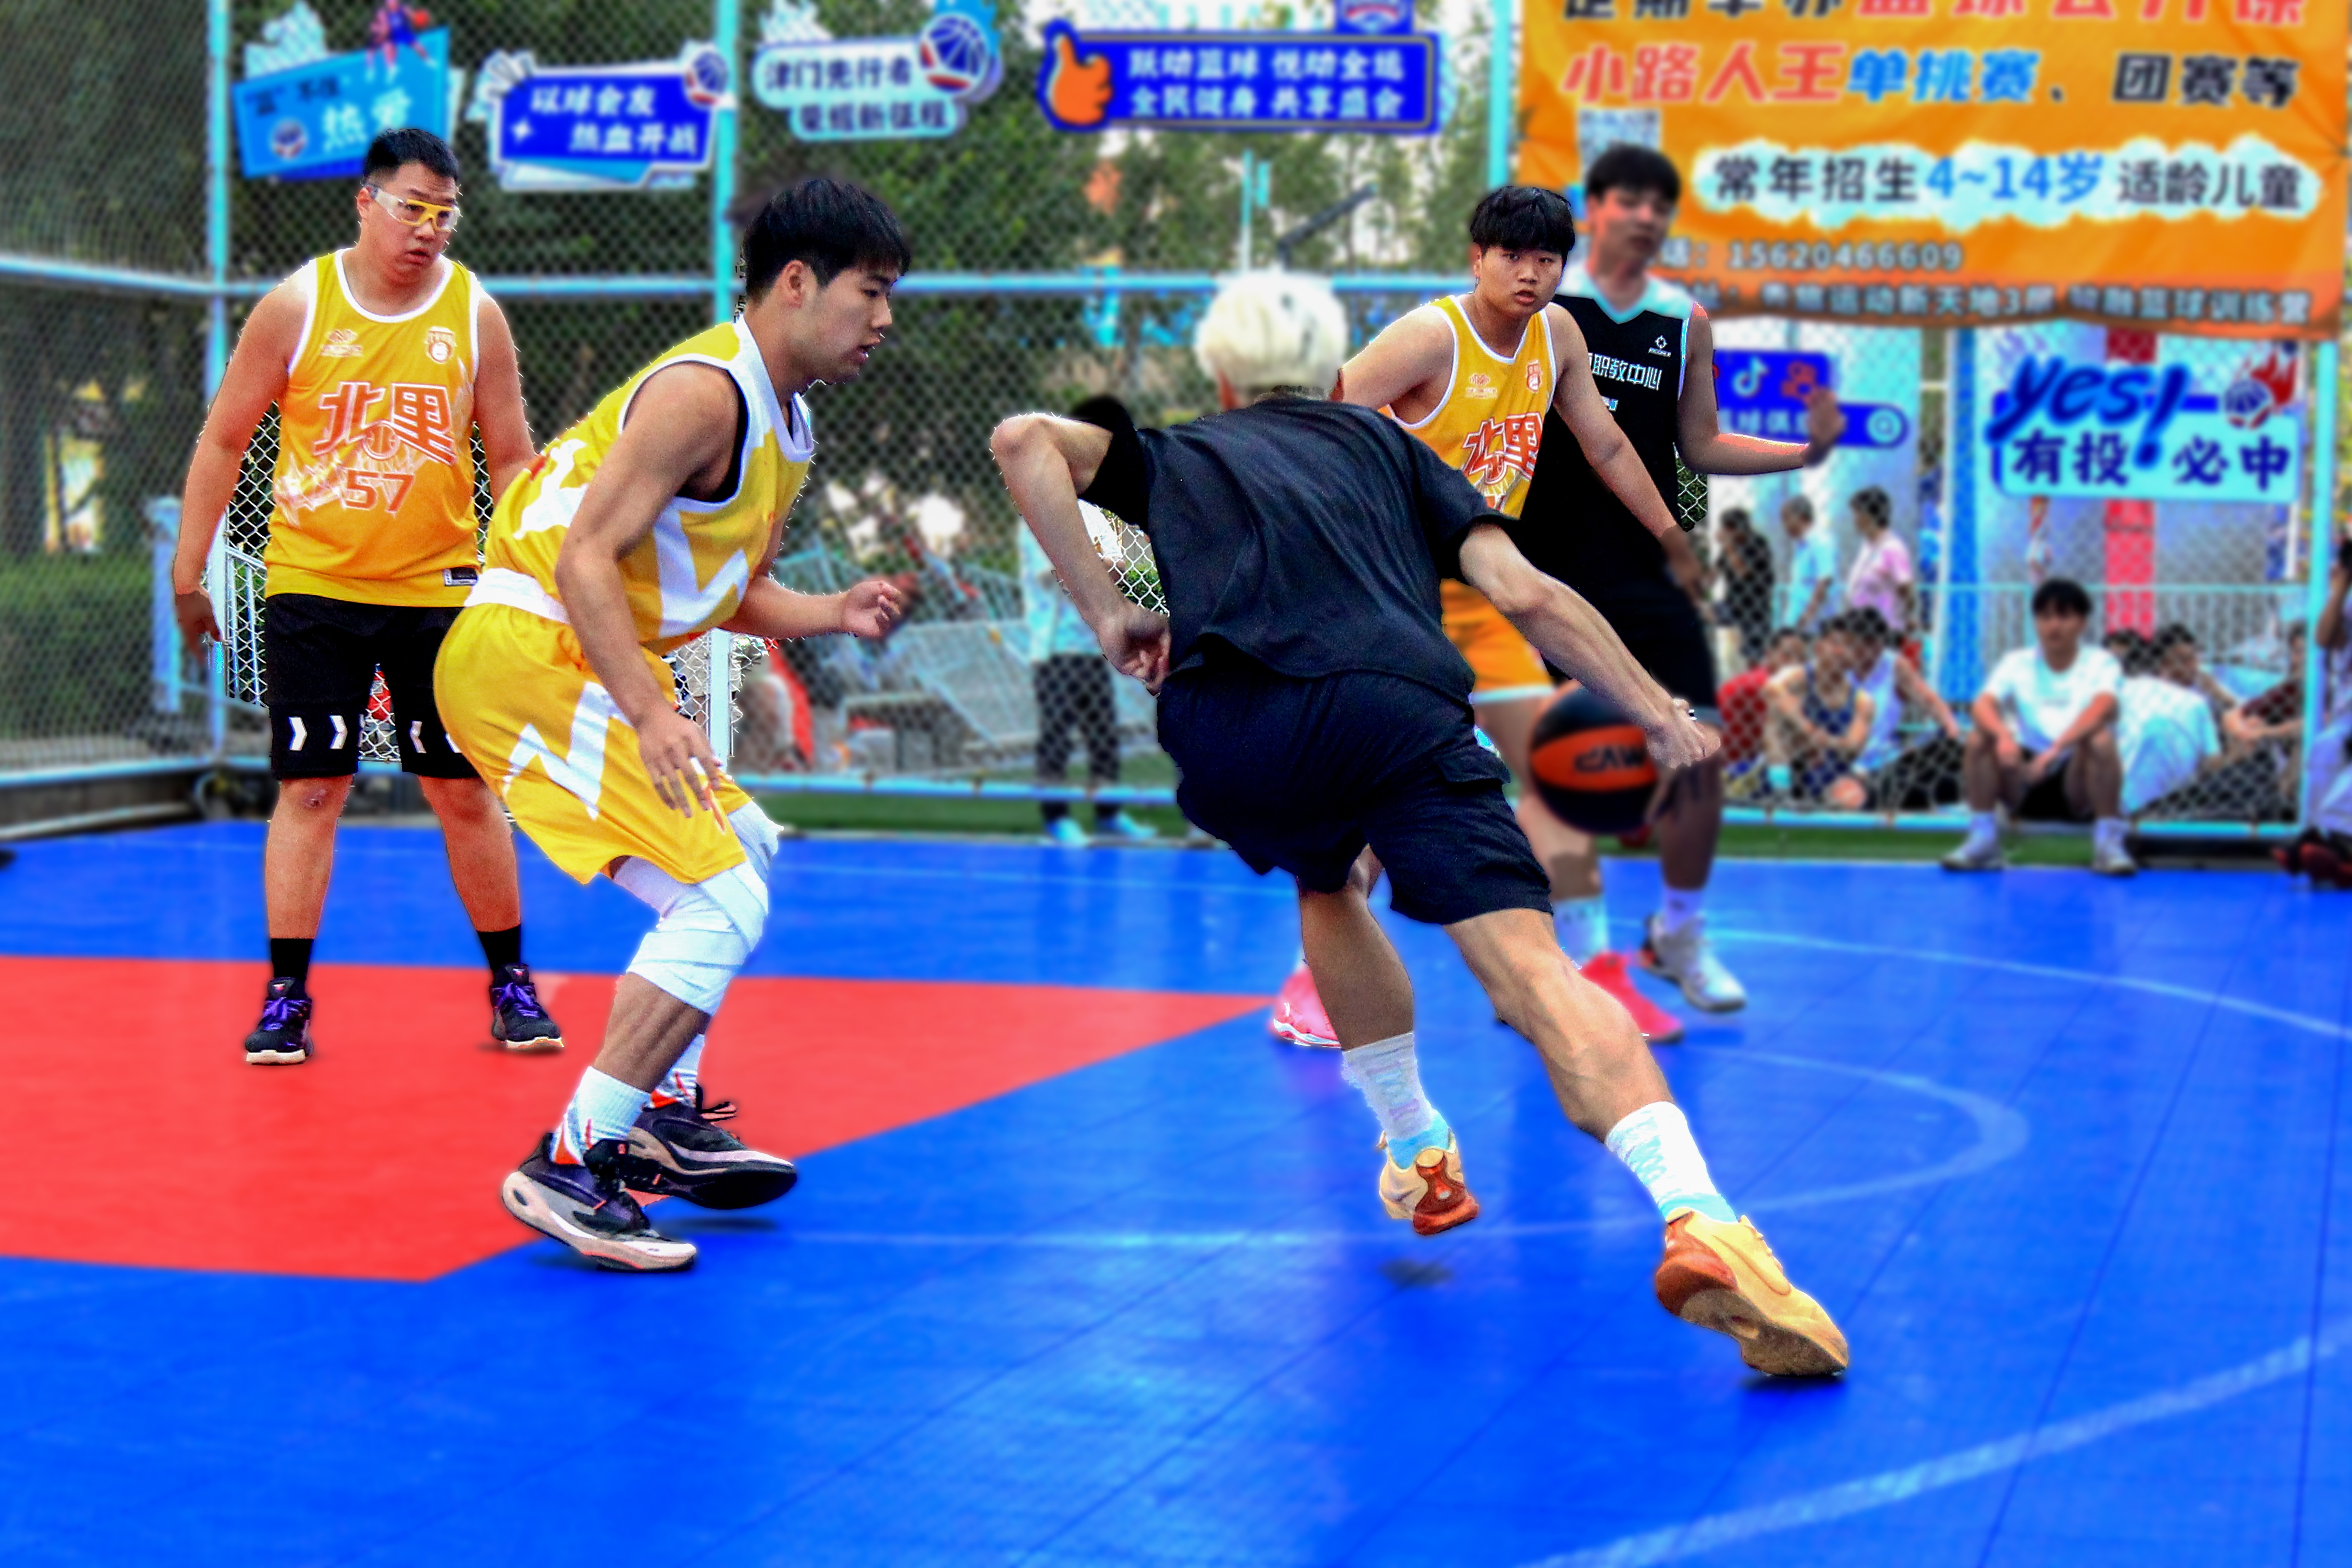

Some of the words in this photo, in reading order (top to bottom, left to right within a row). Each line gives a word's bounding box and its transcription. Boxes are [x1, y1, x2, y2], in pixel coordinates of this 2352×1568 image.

[531, 85, 657, 116] 以球会友
[1130, 86, 1256, 118] 全民健身
[568, 122, 697, 155] 热血开战
[1726, 238, 1965, 272] 15620466609
[2011, 428, 2129, 487] 有投
[2172, 433, 2291, 492] 必中
[341, 469, 415, 514] 57
